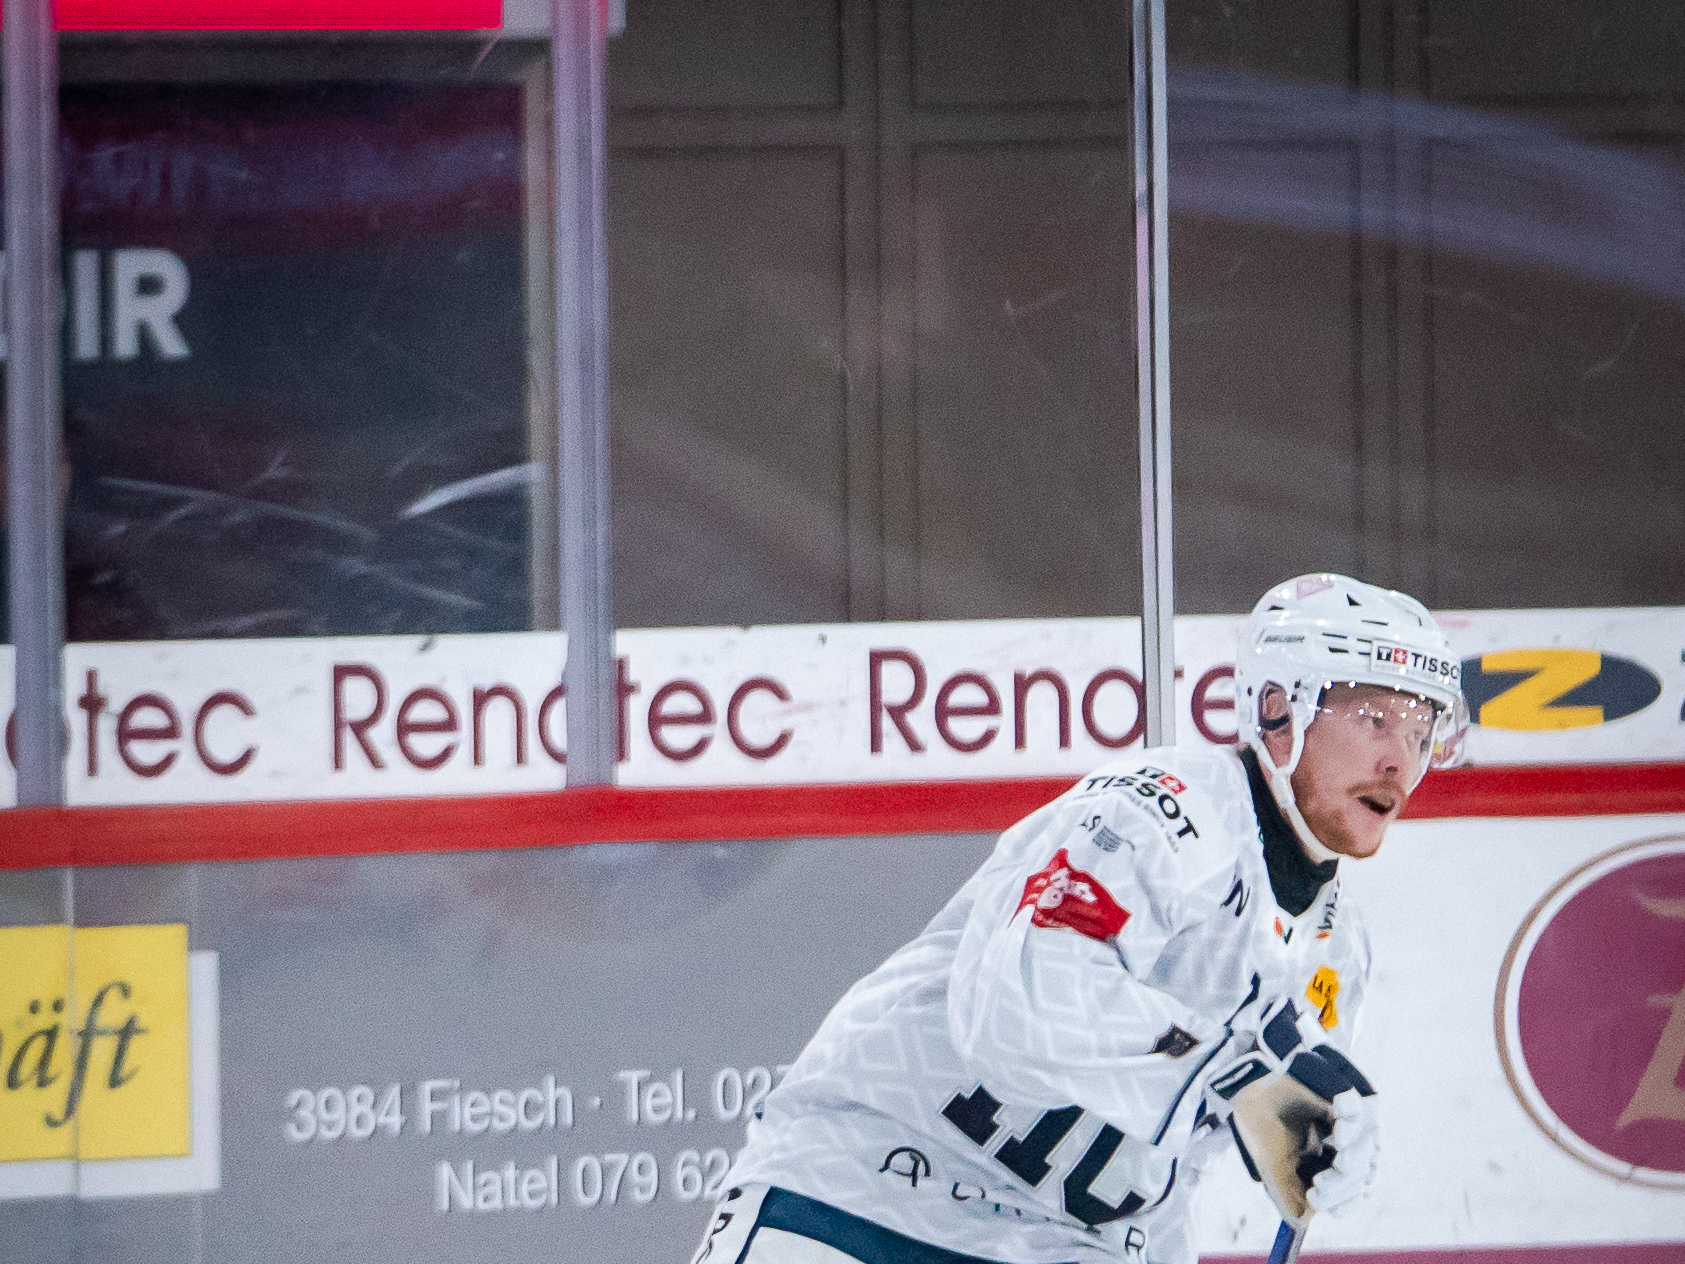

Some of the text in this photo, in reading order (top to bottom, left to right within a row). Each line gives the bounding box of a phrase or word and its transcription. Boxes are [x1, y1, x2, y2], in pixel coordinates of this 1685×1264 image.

[0, 247, 192, 361] IR
[1087, 775, 1200, 840] TISSOT
[0, 979, 148, 1128] äft
[285, 1083, 405, 1142] 3984
[418, 1074, 576, 1136] Fiesch
[618, 1067, 699, 1123] Tel.
[437, 1155, 561, 1213] Natel
[576, 1151, 660, 1207] 079
